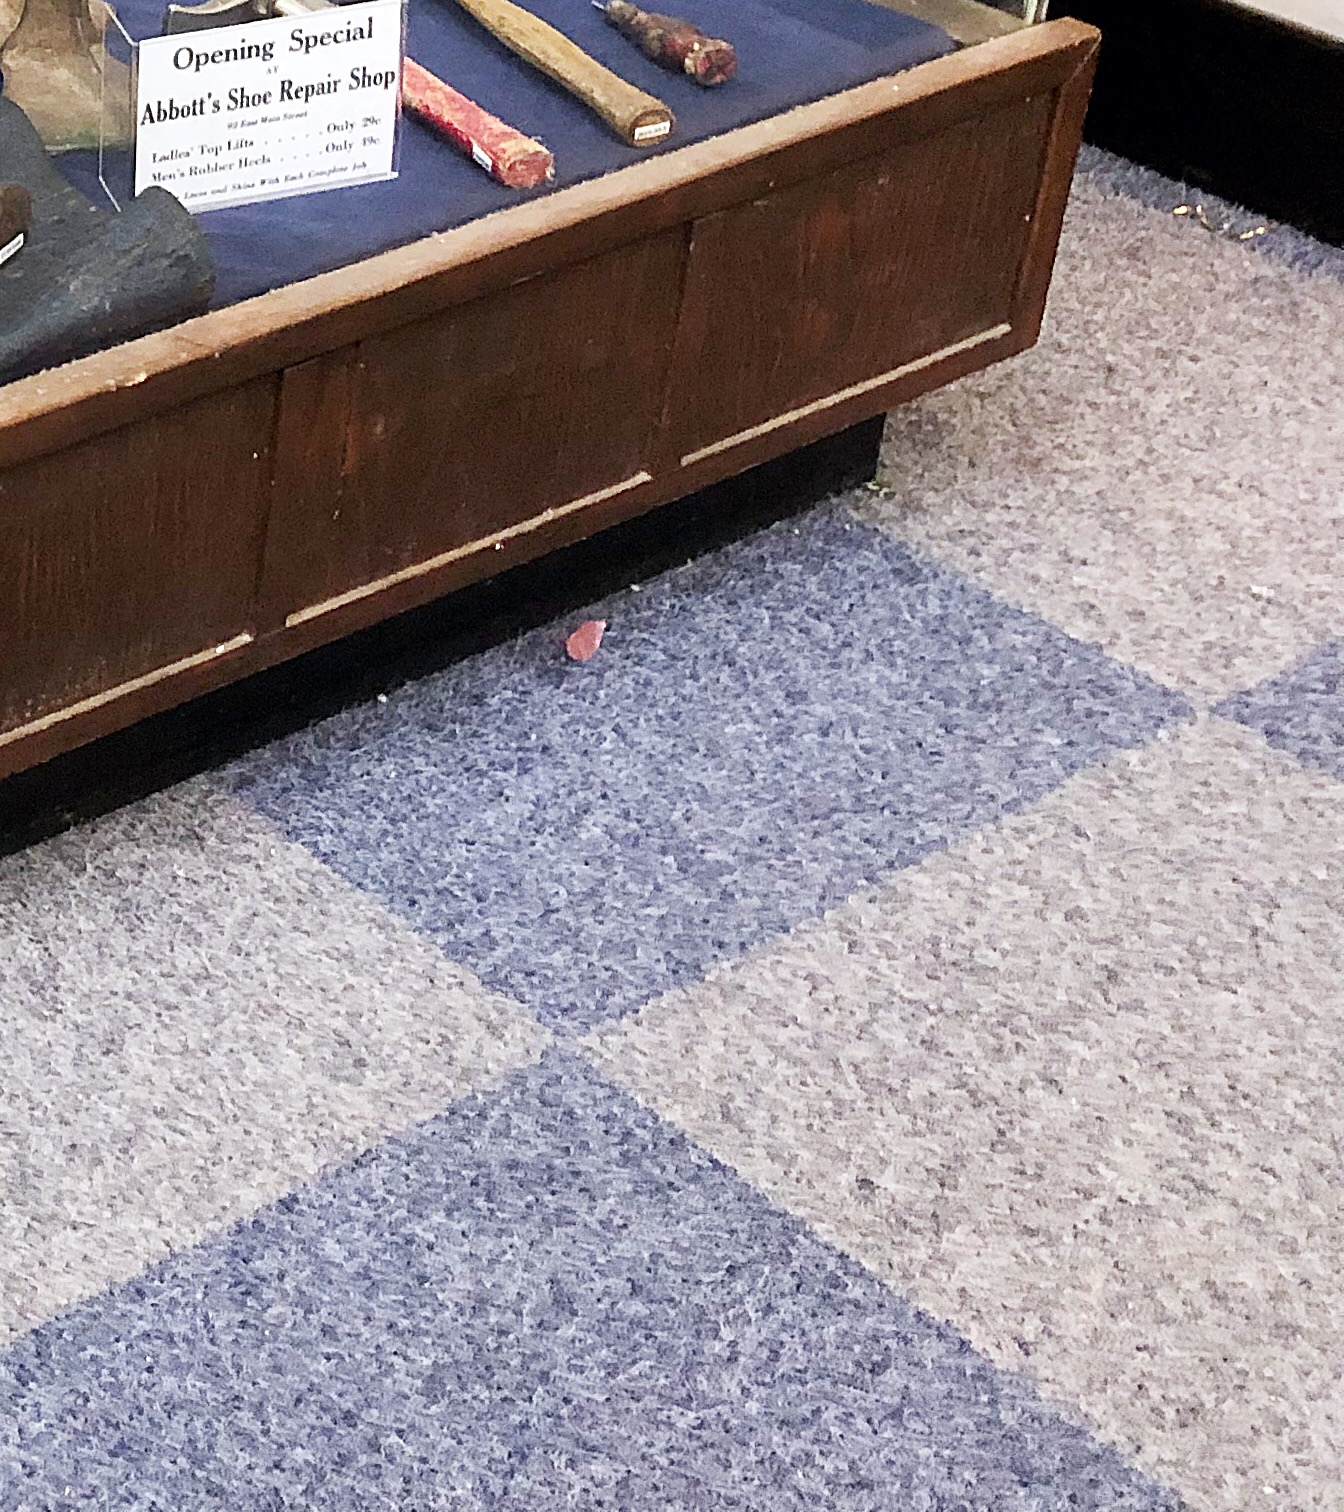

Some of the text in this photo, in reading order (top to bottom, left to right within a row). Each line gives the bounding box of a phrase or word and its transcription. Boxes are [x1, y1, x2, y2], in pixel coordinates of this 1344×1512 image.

[172, 16, 374, 73] Opening Special
[140, 66, 396, 126] Abbott's Shoe Repair Shop
[152, 168, 185, 183] Men's
[189, 162, 234, 177] Rubber
[238, 155, 271, 169] Heels
[325, 140, 354, 155] Only
[198, 144, 223, 157] Top
[227, 138, 254, 151] Lifts
[327, 120, 356, 136] Only
